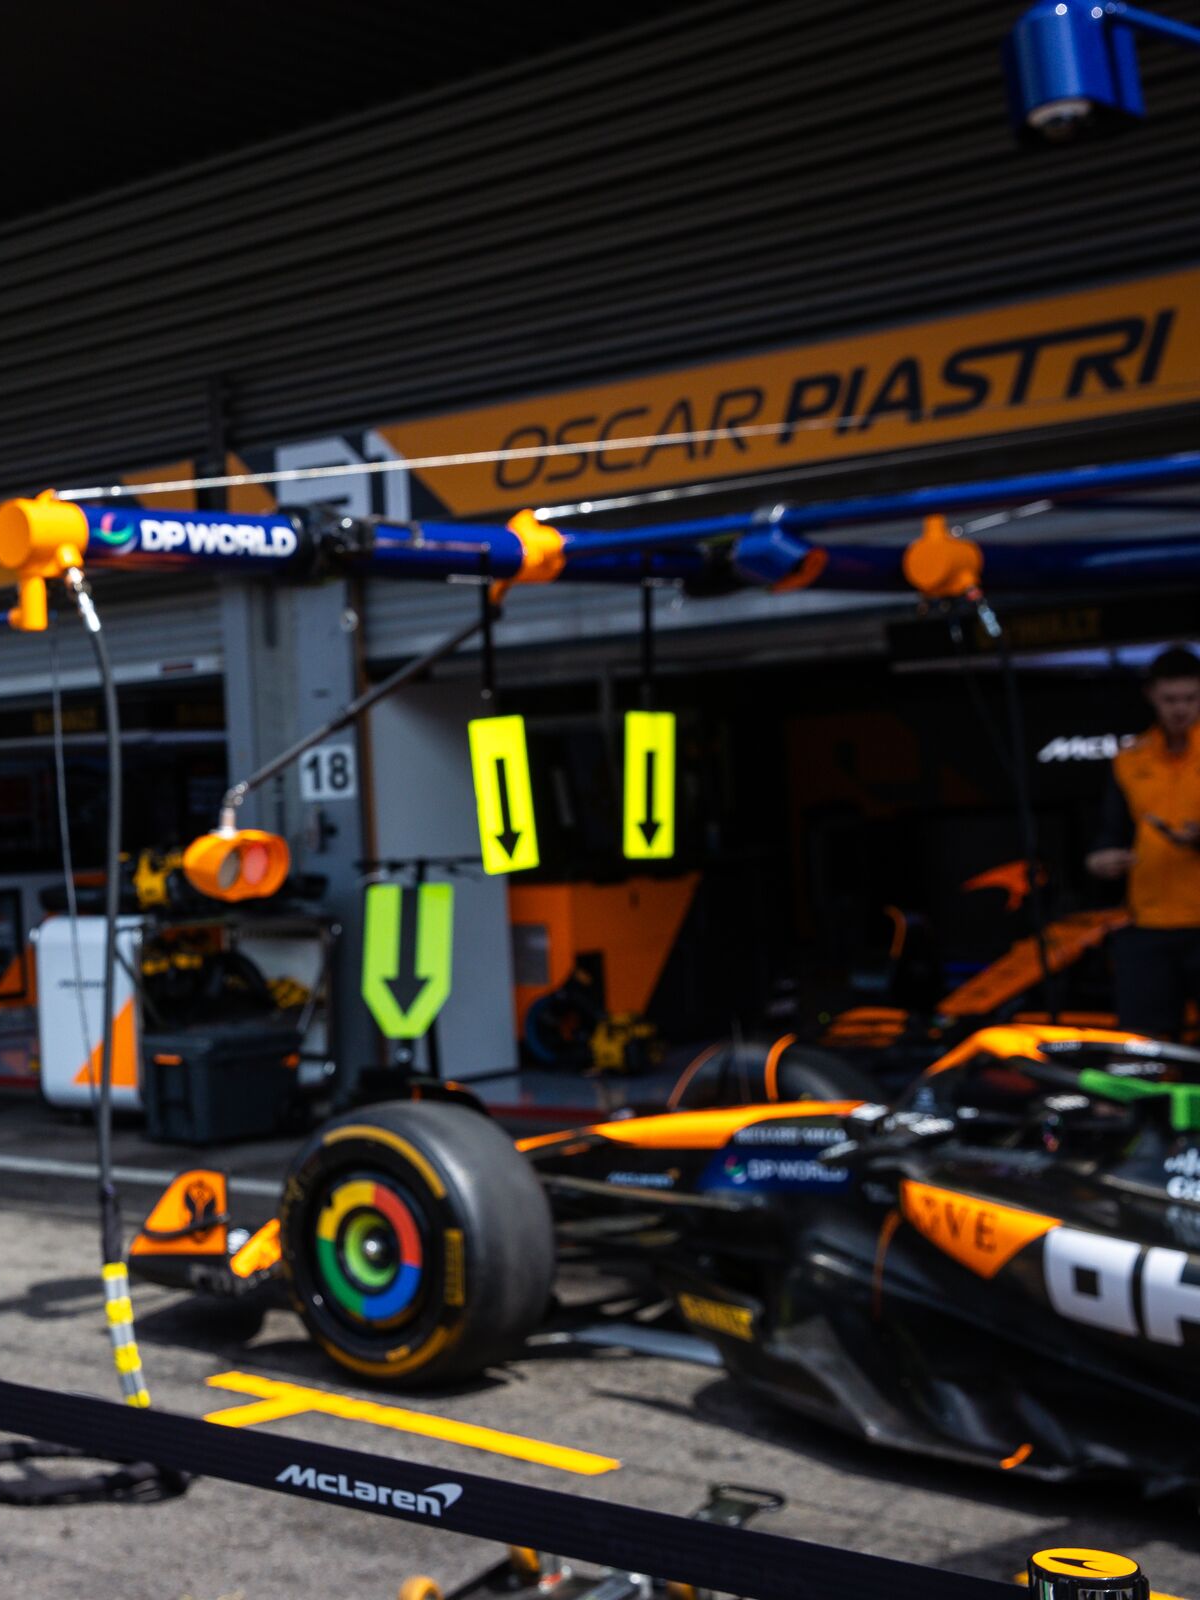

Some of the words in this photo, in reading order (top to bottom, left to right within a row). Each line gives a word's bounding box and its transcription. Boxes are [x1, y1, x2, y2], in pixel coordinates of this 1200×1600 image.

[494, 387, 764, 491] OSCAR
[779, 308, 1177, 446] PIASTRI
[140, 519, 187, 551] DP
[188, 523, 297, 557] WORLD
[307, 751, 349, 792] 18
[275, 1464, 442, 1517] McLaren
